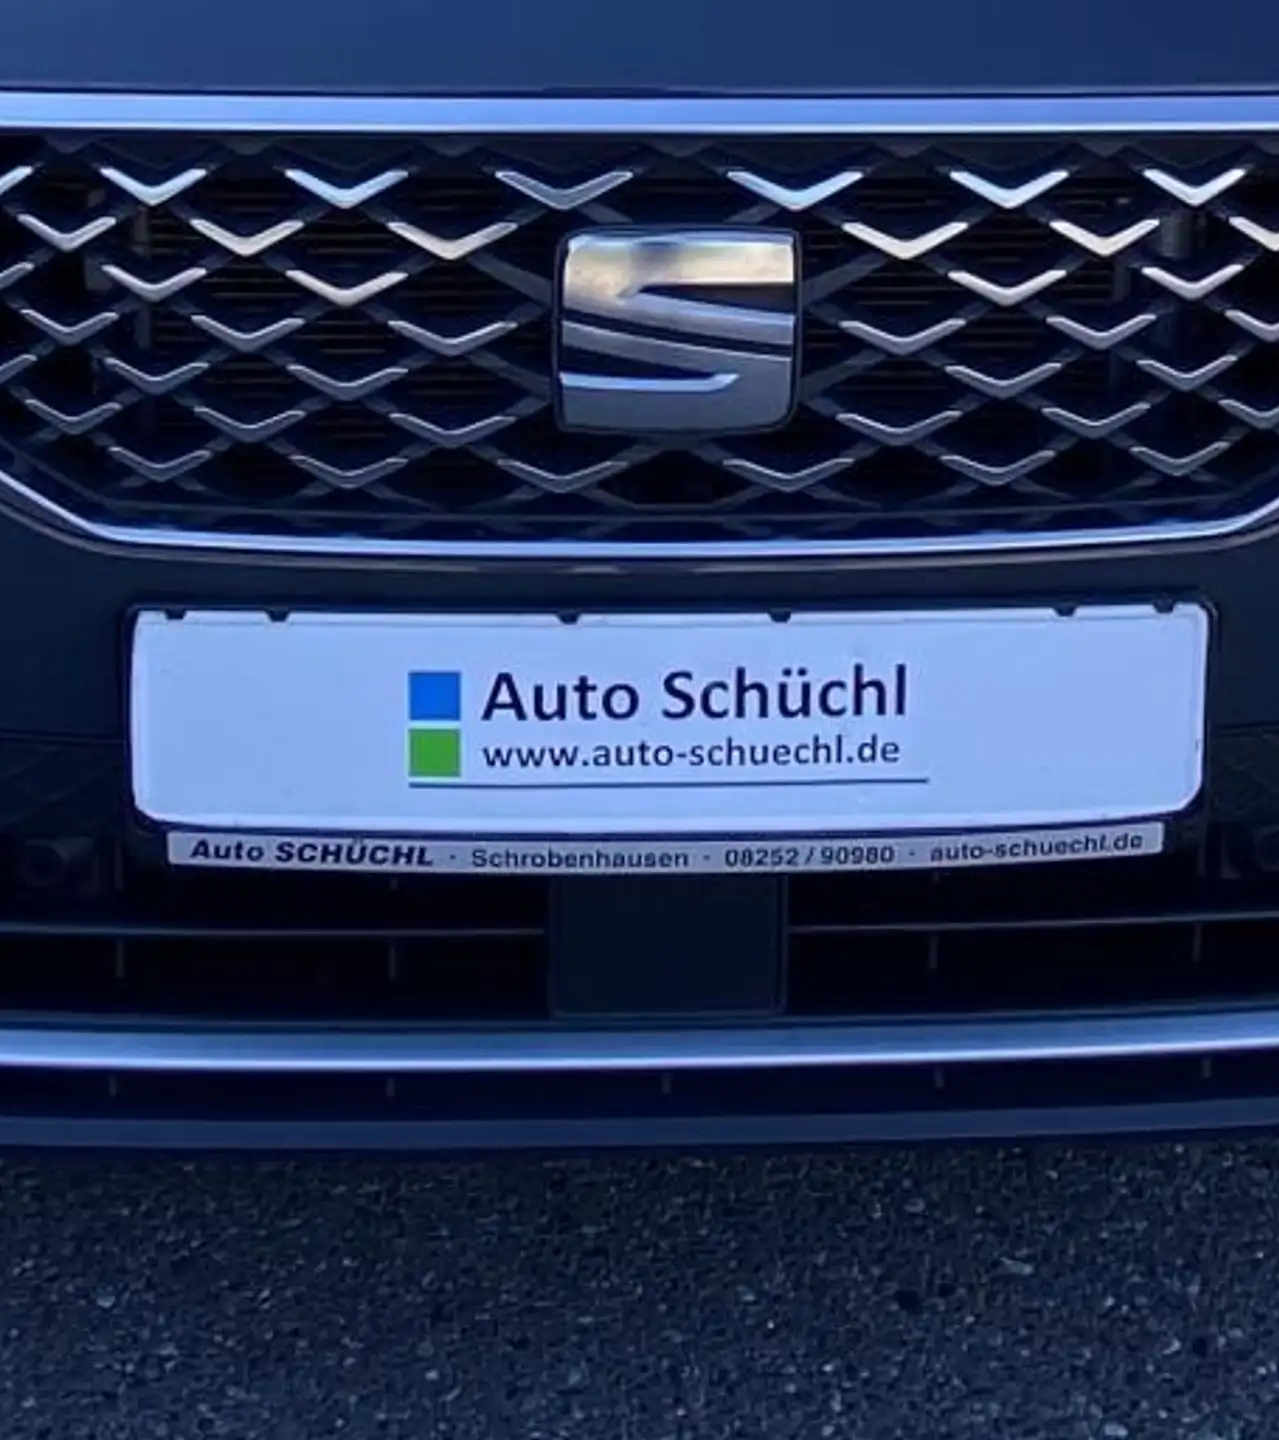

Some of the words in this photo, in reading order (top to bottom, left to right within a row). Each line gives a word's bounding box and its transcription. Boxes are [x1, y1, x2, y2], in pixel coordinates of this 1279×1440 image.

[481, 671, 640, 722] Auto
[661, 663, 908, 720] Schüchl
[483, 734, 901, 768] www.auto-schuechl.de
[190, 839, 265, 862] Auto
[274, 838, 434, 867] SCHÜCHL
[471, 848, 690, 870] Schrobenhausen
[930, 832, 1144, 863] auto-schuechl.de
